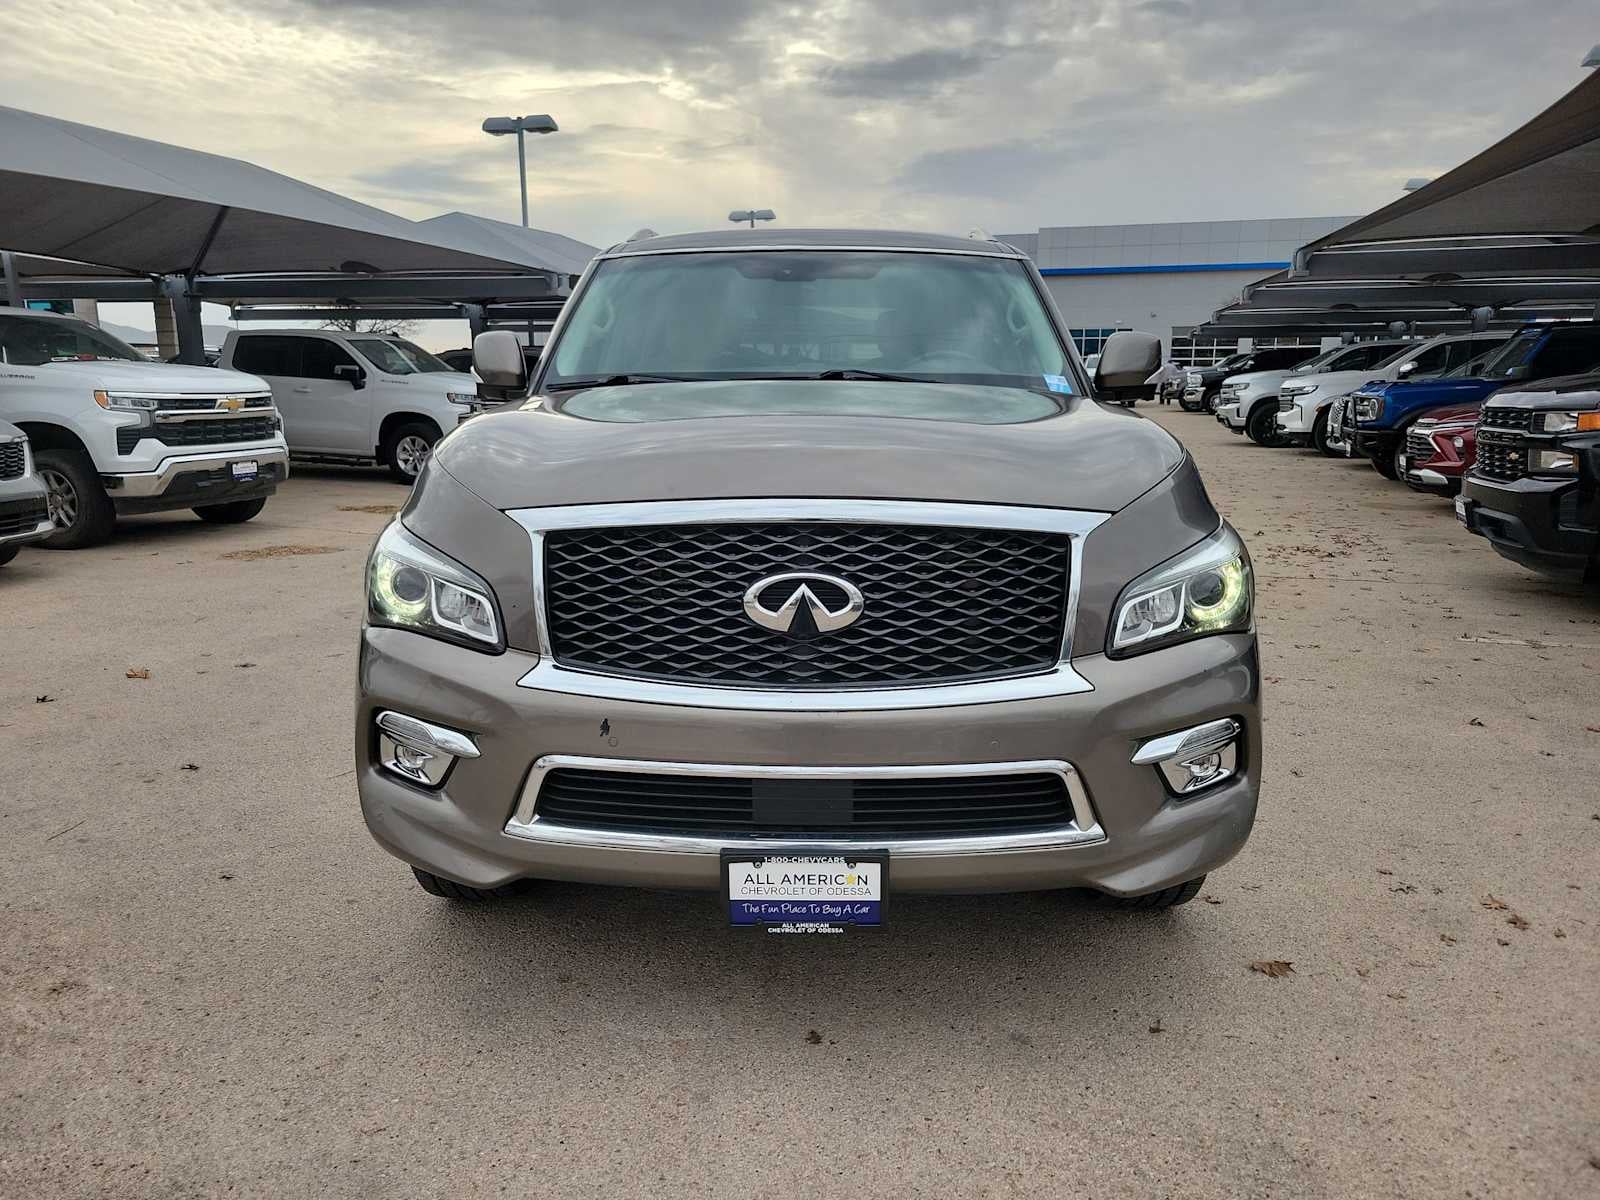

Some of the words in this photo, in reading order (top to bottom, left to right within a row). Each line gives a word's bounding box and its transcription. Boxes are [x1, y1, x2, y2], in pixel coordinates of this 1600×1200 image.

[764, 856, 845, 864] 1-800-CHEVYCARS
[743, 873, 774, 885] ALL
[740, 886, 806, 896] CHEVROLET
[809, 887, 823, 896] OF
[826, 887, 872, 896] ODESSA
[742, 903, 760, 913] The
[761, 903, 779, 913] Fun
[781, 902, 807, 914] Place
[808, 903, 820, 914] To
[822, 904, 842, 917] Buy
[843, 904, 852, 914] A
[853, 904, 870, 914] Car
